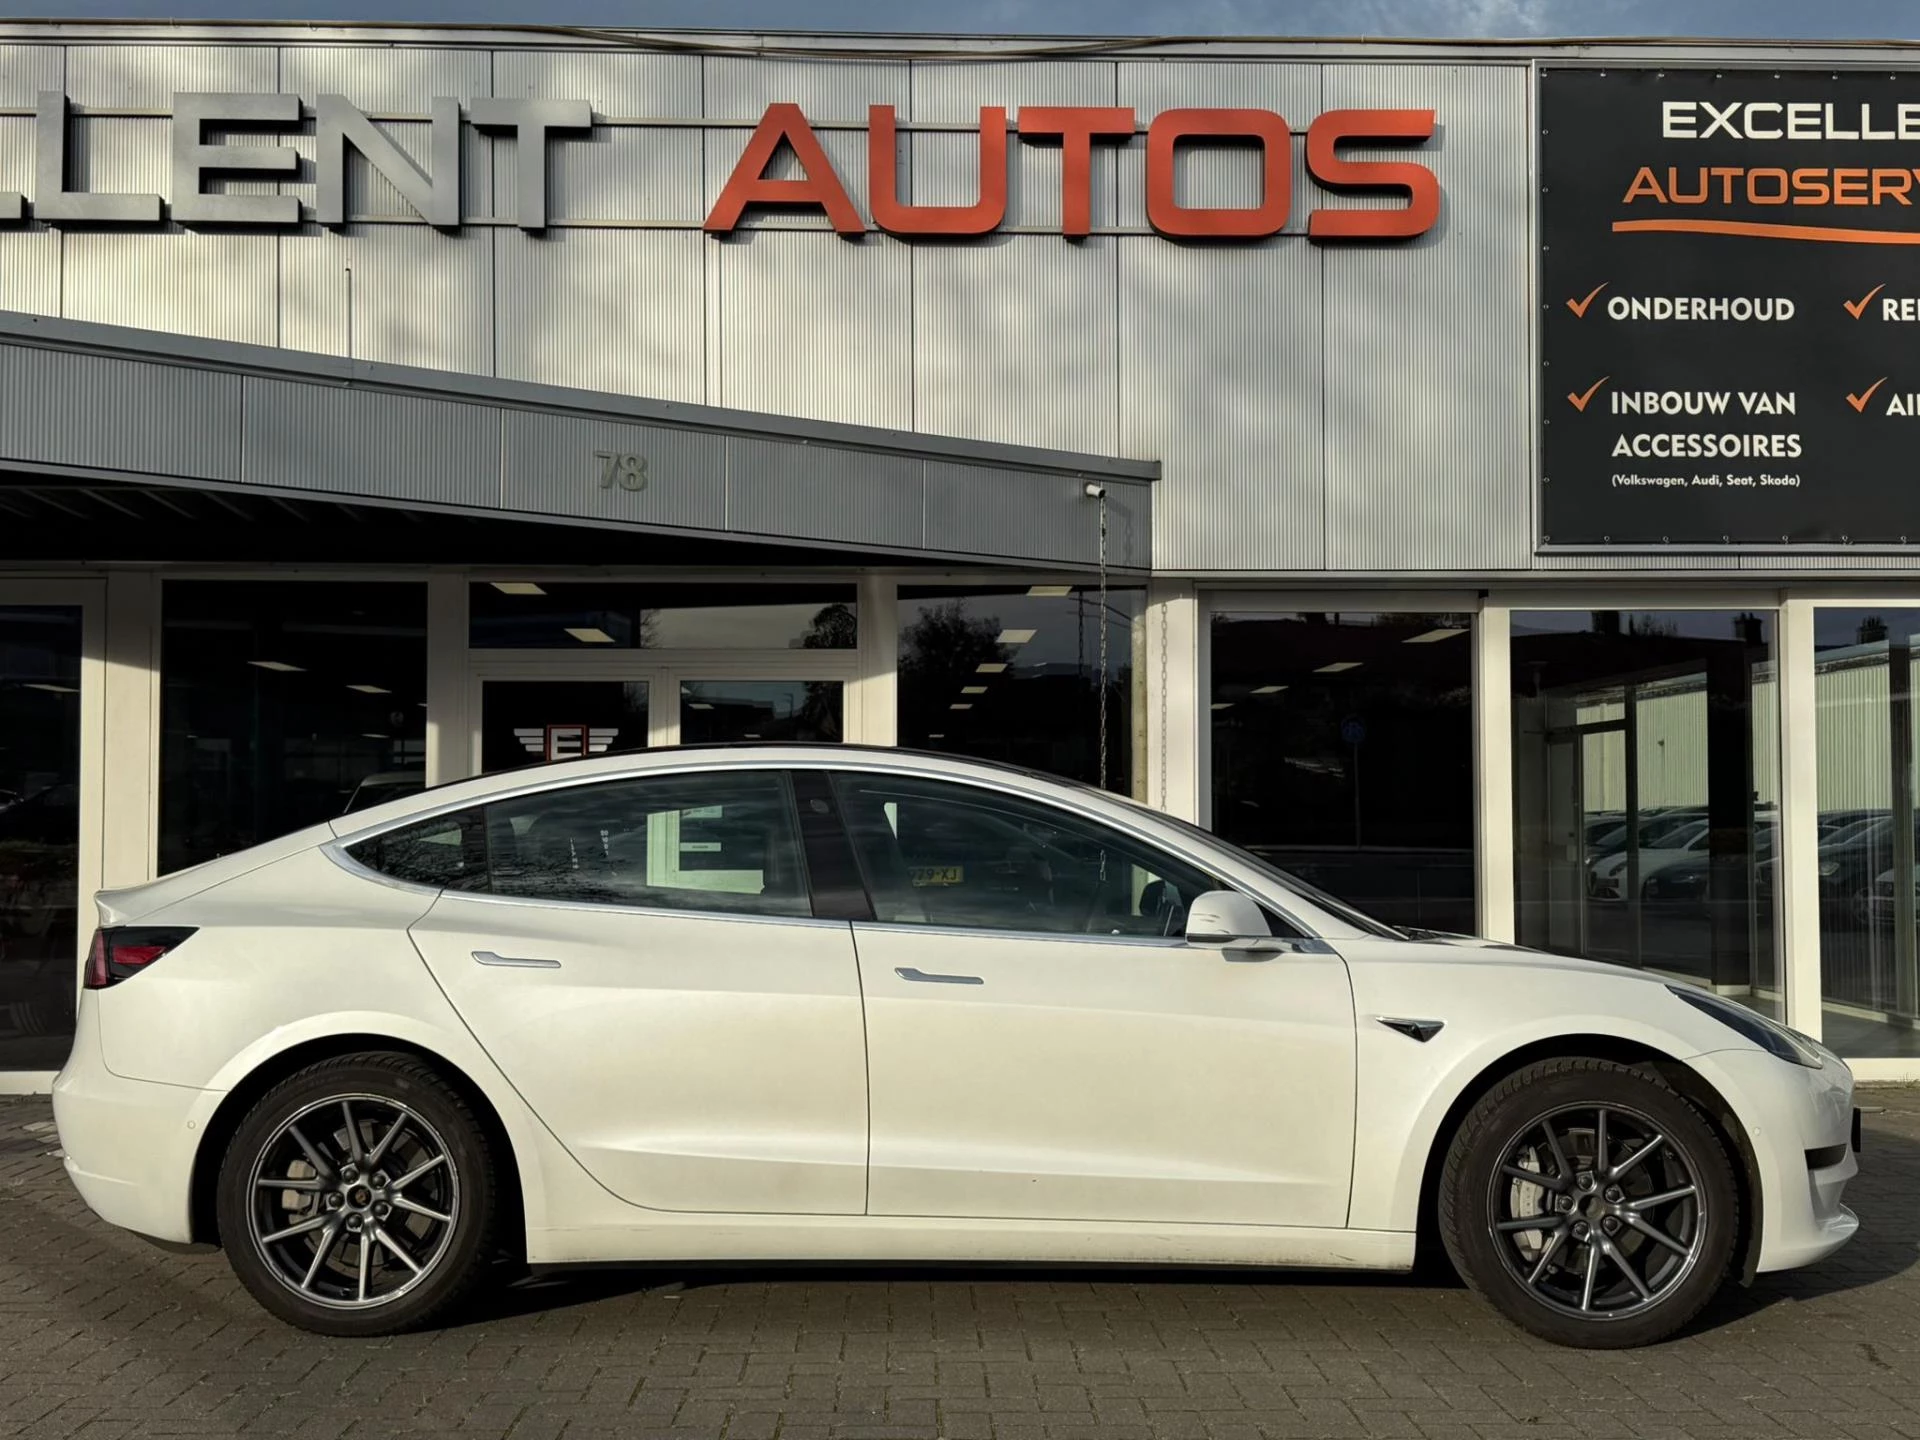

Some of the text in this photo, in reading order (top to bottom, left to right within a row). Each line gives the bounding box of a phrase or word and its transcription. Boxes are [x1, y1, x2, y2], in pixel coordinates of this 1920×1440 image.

[0, 90, 1440, 240] LENT AUTOS
[1622, 166, 1920, 206] AUTOSER
[1607, 295, 1796, 321] ONDERHOUD
[1882, 298, 1920, 322] RE
[1611, 391, 1797, 416] INBOUW VAN
[1885, 393, 1920, 417] AI
[1611, 433, 1803, 459] ACCESSOIRES
[594, 450, 645, 491] 78
[1611, 474, 1801, 488] (Volkswagen, Audi, Seat, Skoda)
